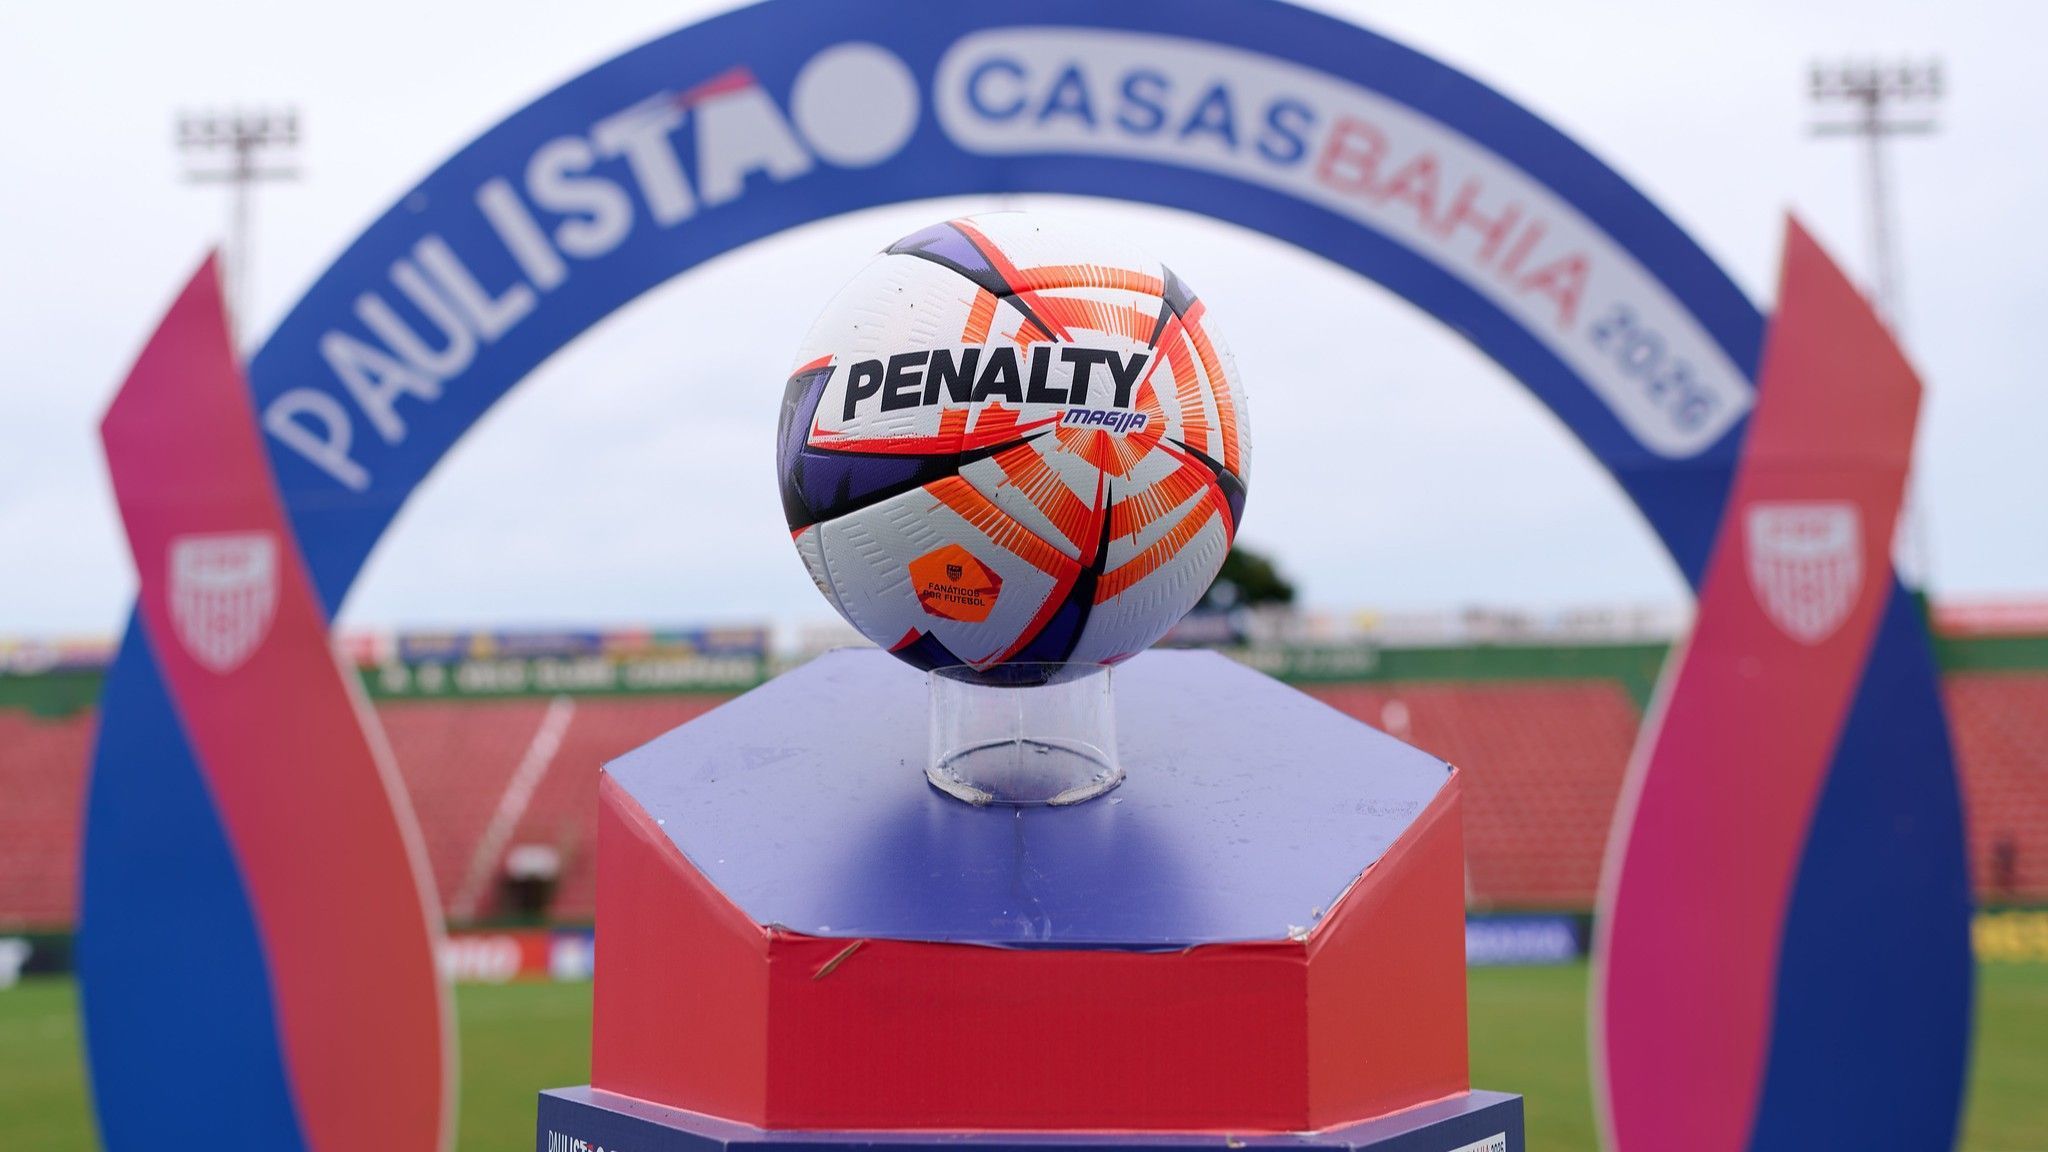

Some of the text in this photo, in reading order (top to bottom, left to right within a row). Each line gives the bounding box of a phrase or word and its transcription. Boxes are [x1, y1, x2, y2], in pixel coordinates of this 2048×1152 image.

[842, 347, 1149, 421] PENALTY
[1589, 302, 1719, 431] 2026
[928, 582, 980, 597] FANÁTICOS
[944, 594, 986, 607] FUTEBOL
